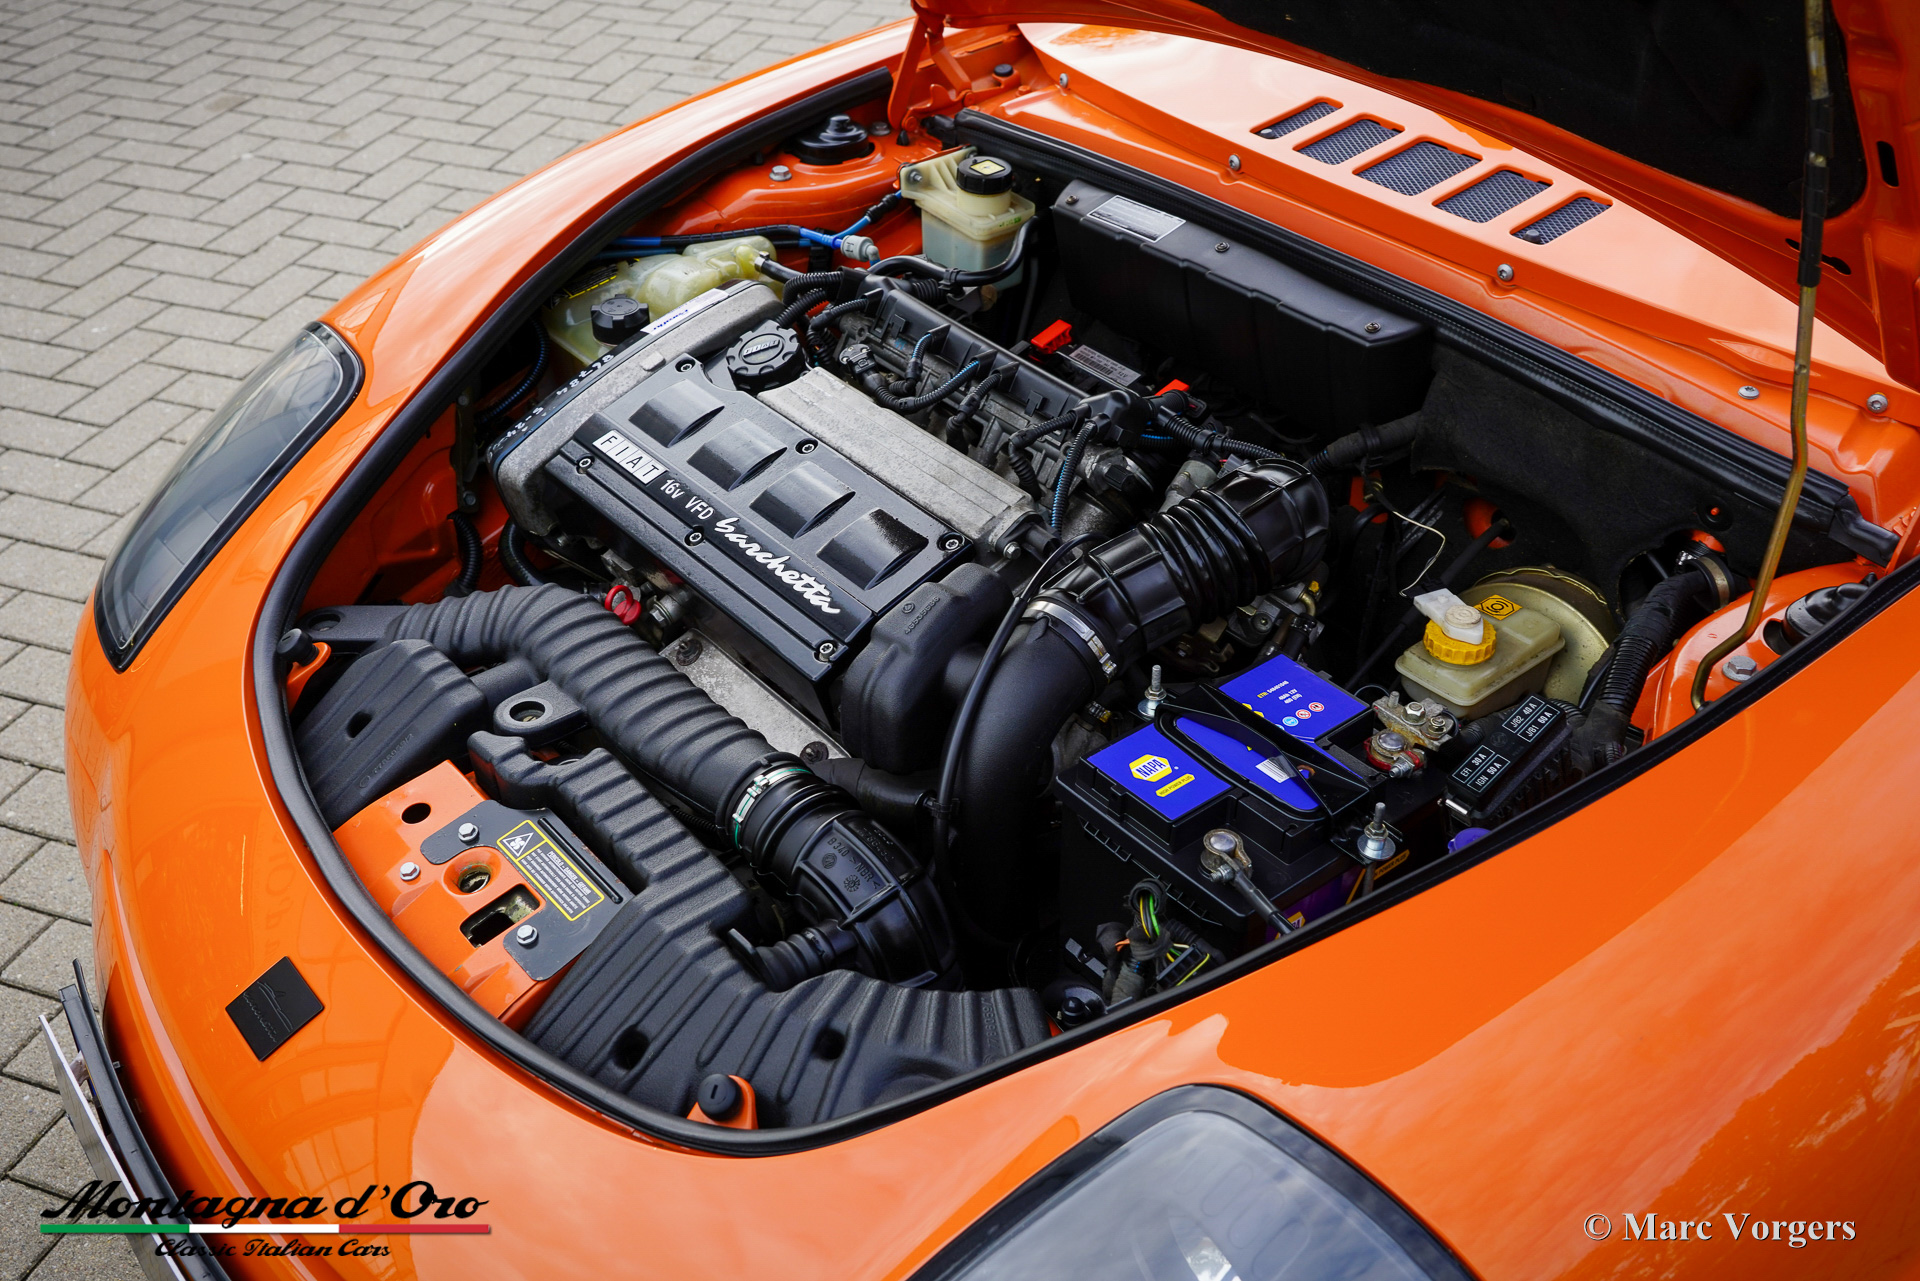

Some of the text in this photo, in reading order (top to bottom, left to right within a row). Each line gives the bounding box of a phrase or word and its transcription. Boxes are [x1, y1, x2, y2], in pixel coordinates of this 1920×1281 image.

[597, 433, 665, 481] FIAT
[685, 496, 715, 520] VFD
[714, 517, 842, 615] barchetta
[1135, 758, 1167, 778] NAPA
[1459, 767, 1473, 777] EFI
[1167, 780, 1182, 791] POWER
[1475, 774, 1489, 787] IGN
